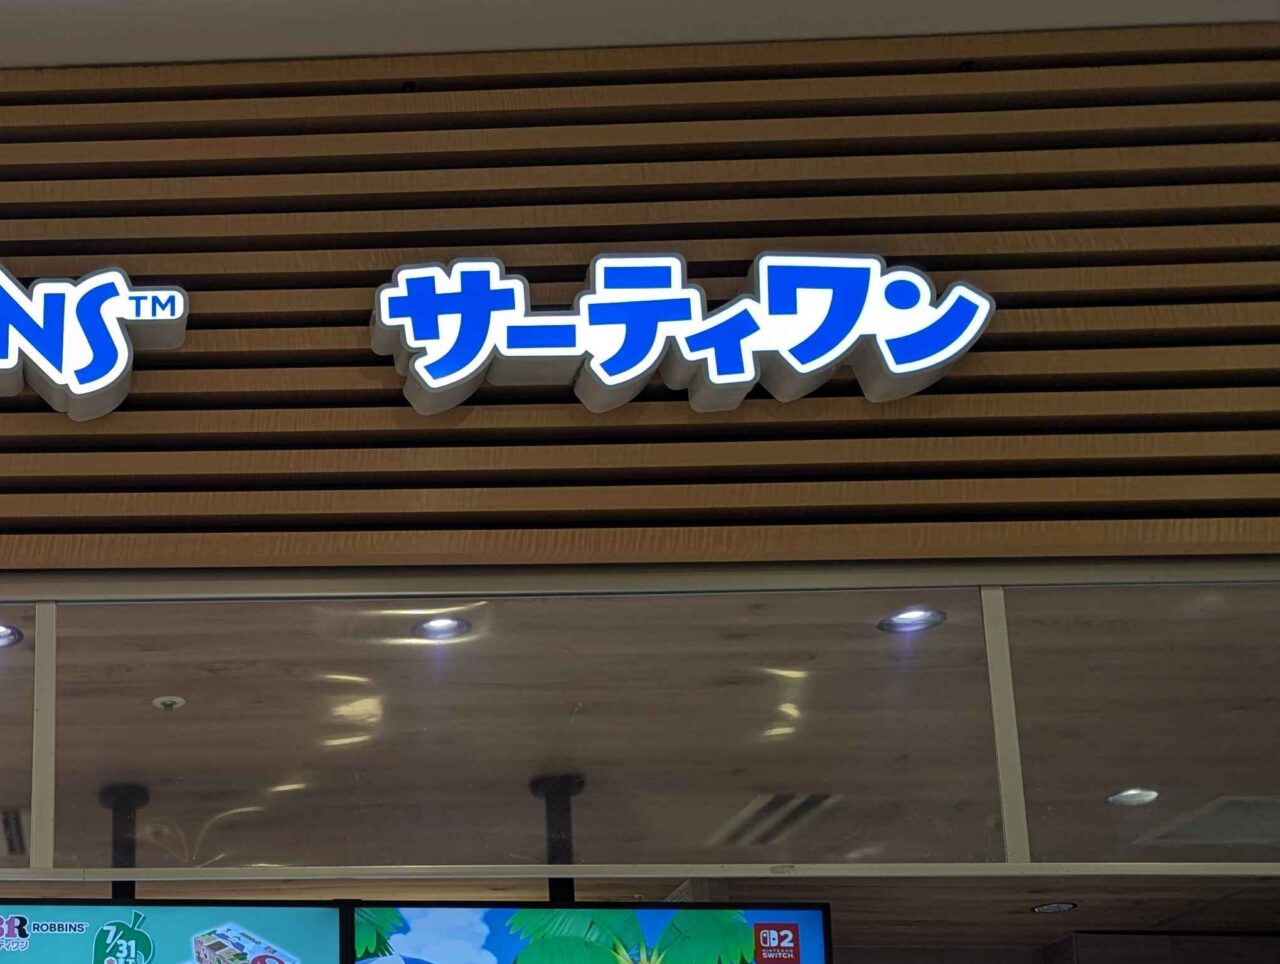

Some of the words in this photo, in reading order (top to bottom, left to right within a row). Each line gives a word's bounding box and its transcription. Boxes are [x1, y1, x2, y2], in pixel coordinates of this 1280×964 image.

[388, 265, 981, 382] サーティワン
[32, 922, 84, 933] ROBBINS
